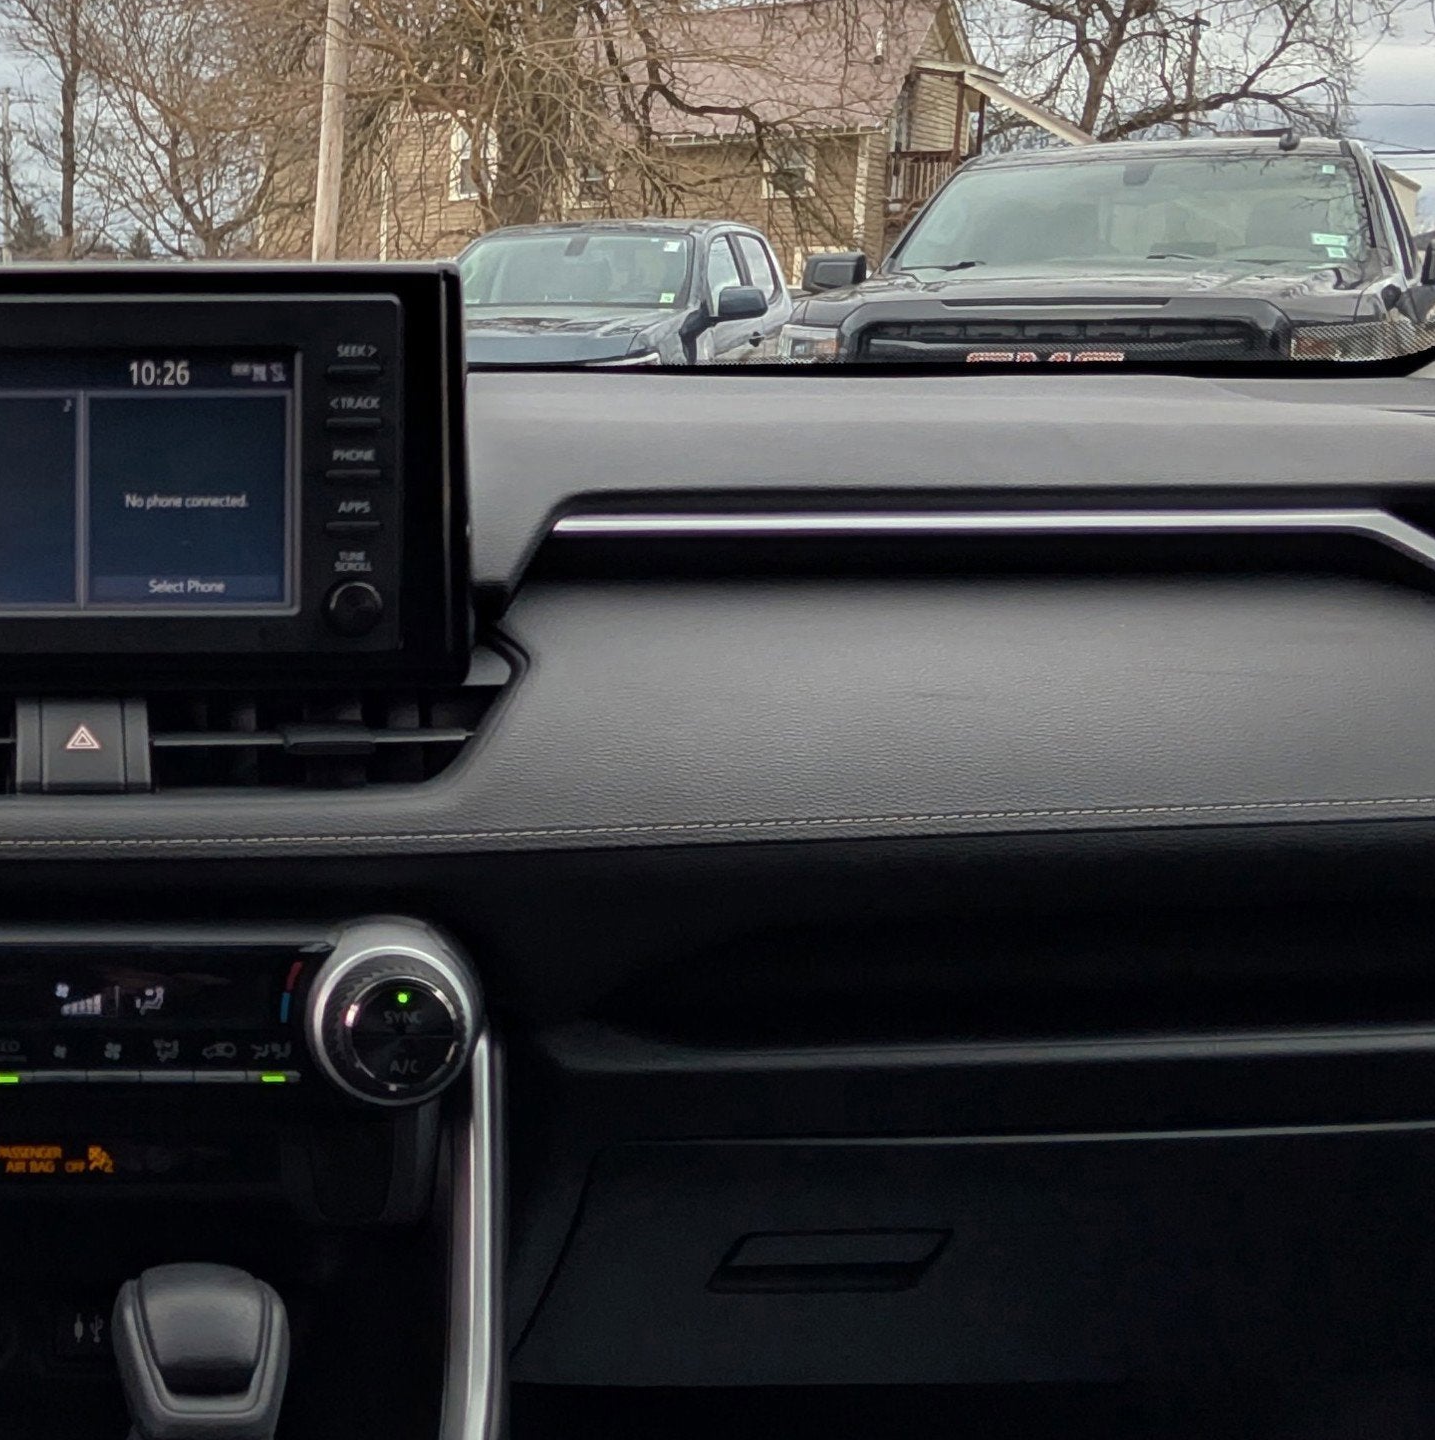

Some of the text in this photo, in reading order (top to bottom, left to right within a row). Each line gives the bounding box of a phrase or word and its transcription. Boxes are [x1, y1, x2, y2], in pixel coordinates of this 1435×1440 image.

[128, 359, 191, 387] 10:26
[332, 448, 376, 462] PHONE
[124, 493, 143, 508] No
[146, 493, 183, 512] phone
[337, 501, 371, 514] APPS
[334, 561, 373, 573] SCROLL
[148, 578, 226, 594] Select Phone
[383, 1010, 423, 1024] SYNC
[389, 1059, 419, 1074] A/C
[5, 1160, 27, 1173] AIR
[29, 1160, 56, 1173] BAG
